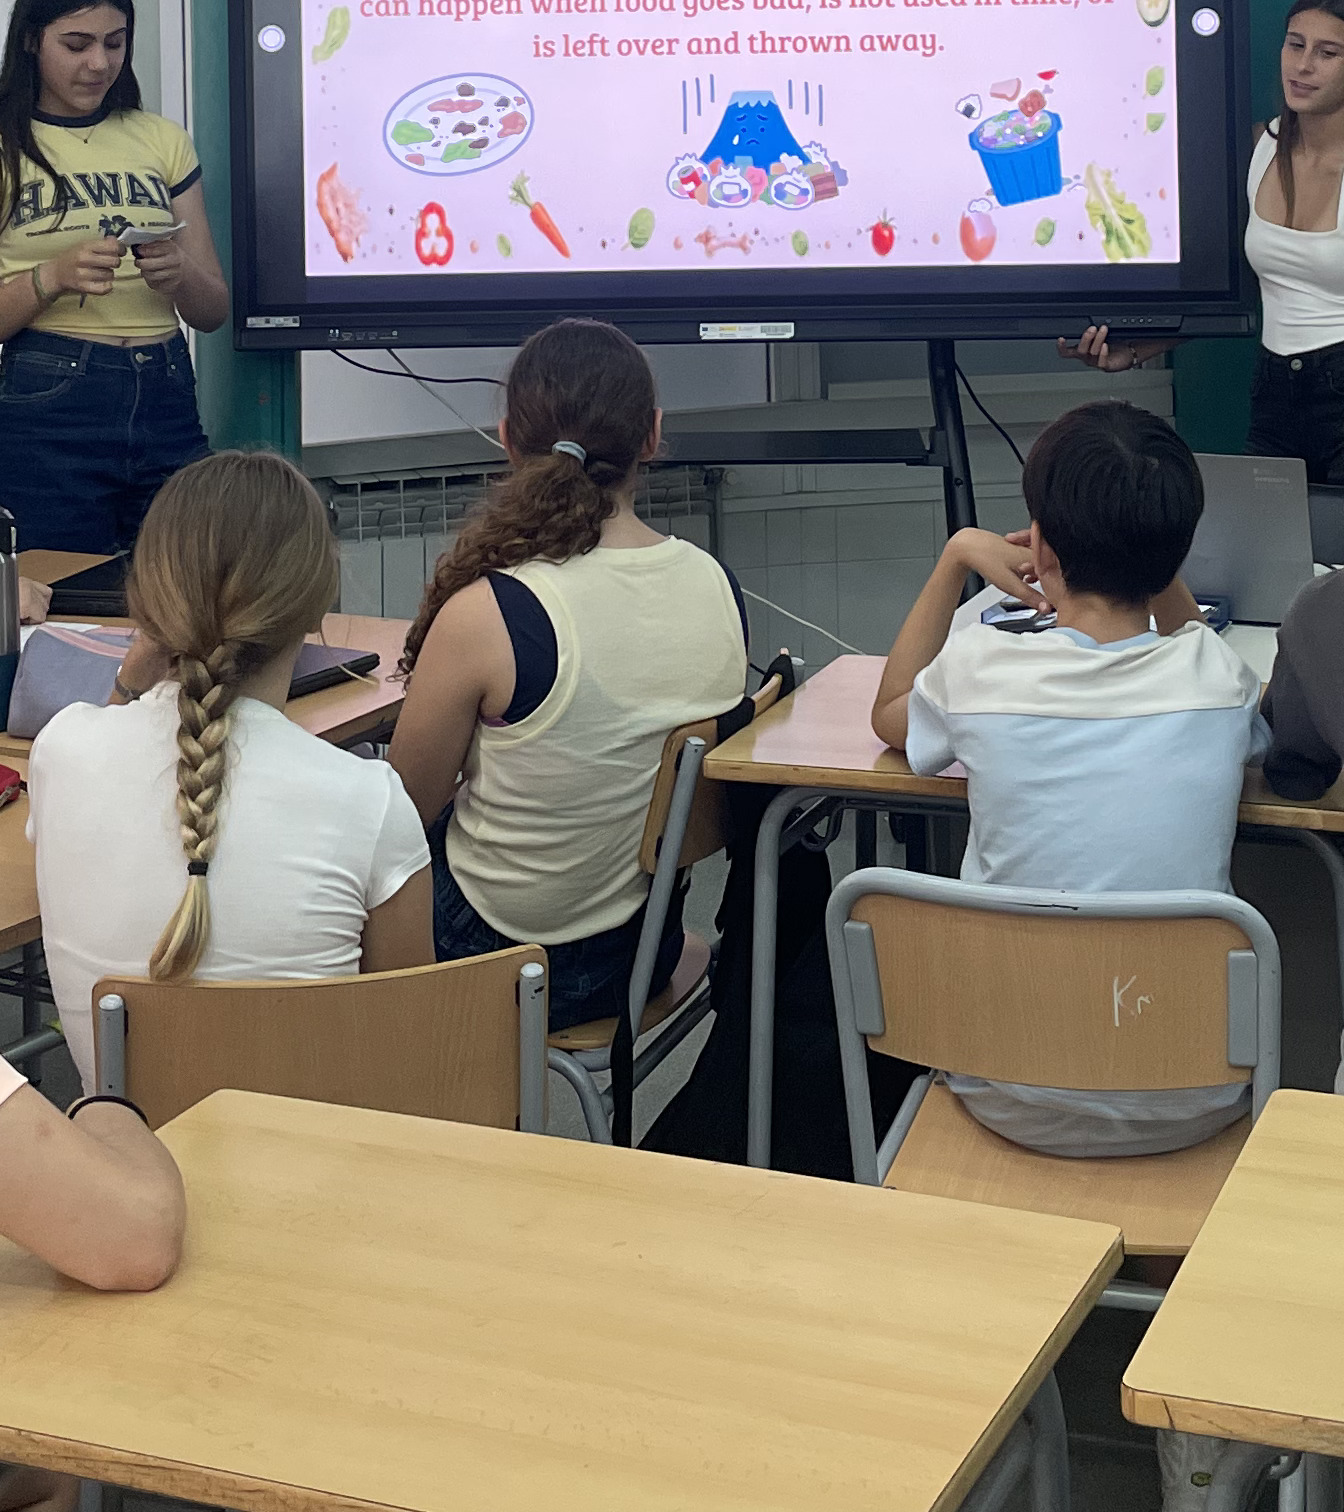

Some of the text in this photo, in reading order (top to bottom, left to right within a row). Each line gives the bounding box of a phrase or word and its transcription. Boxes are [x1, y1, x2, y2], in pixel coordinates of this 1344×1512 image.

[359, 0, 411, 18] can
[532, 30, 945, 58] is left over and thrown away.
